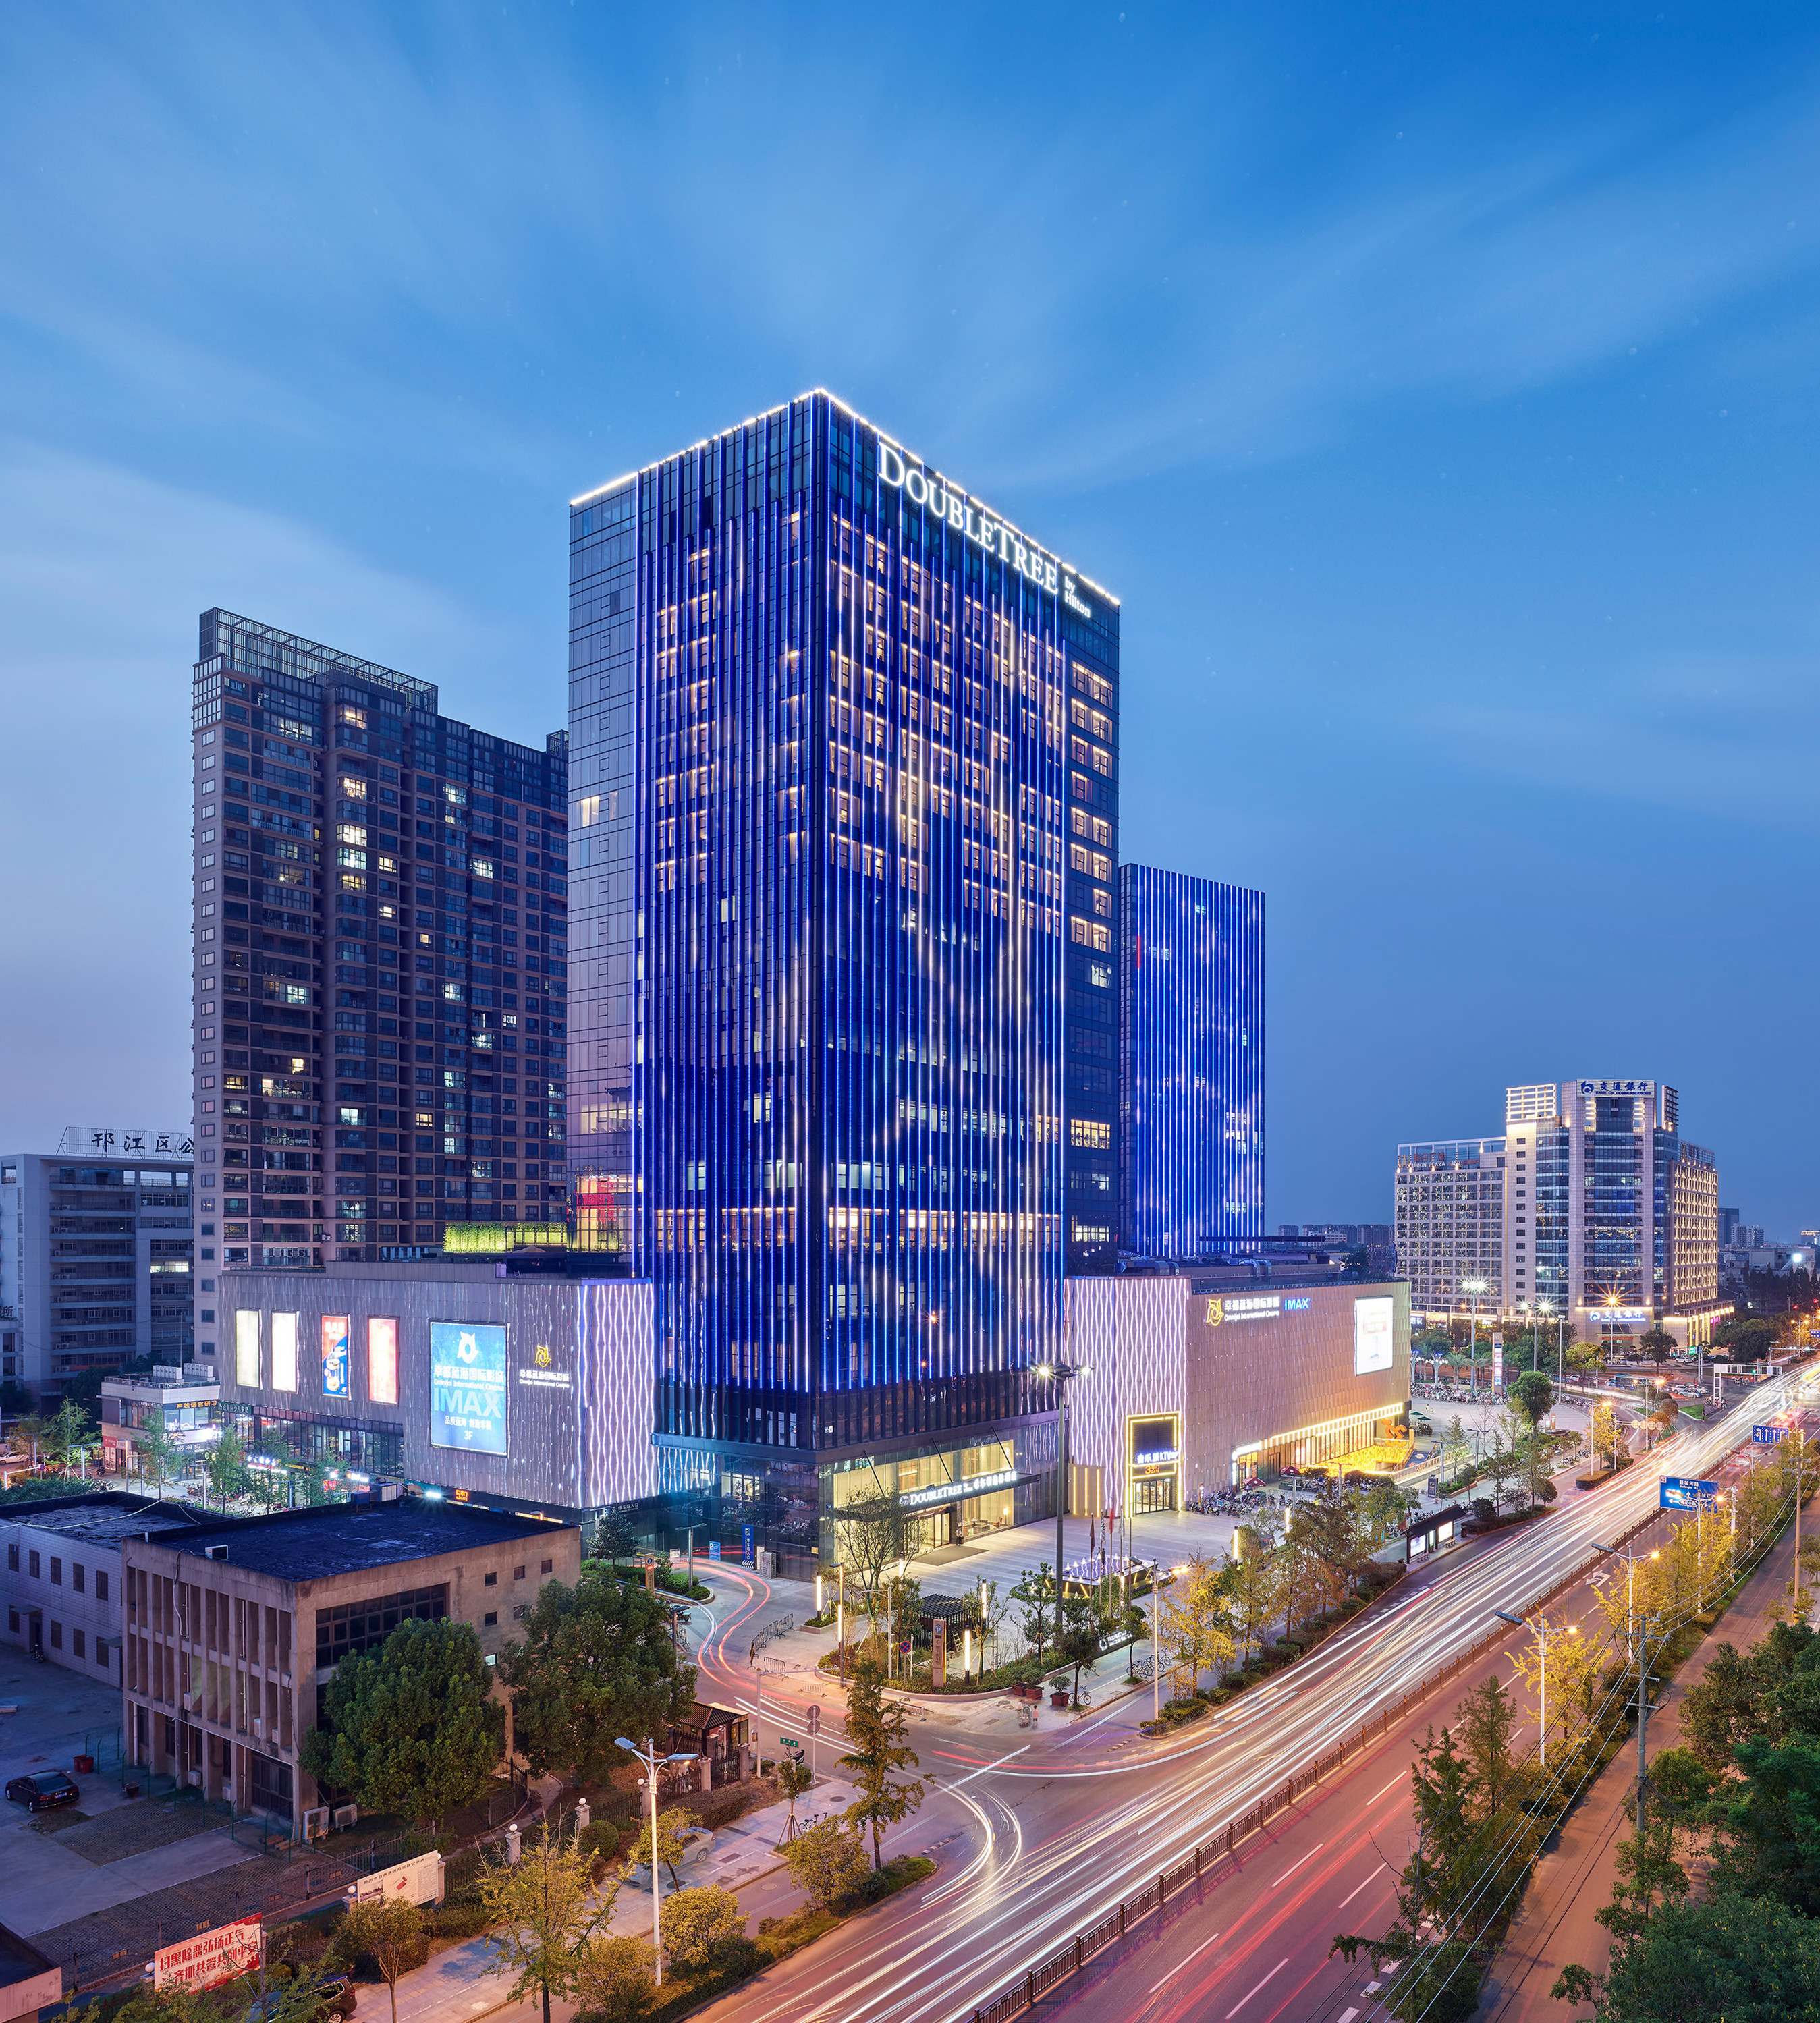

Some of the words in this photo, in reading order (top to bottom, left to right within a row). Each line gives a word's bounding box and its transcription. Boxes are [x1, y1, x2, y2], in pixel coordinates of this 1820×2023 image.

[1065, 576, 1076, 594] by
[1065, 590, 1091, 618] Hilton
[1284, 1298, 1310, 1311] IMAX
[434, 1387, 503, 1419] IMAX
[464, 1430, 473, 1441] 3F
[159, 1927, 244, 1972] 扫黑除恶弘扬正气
